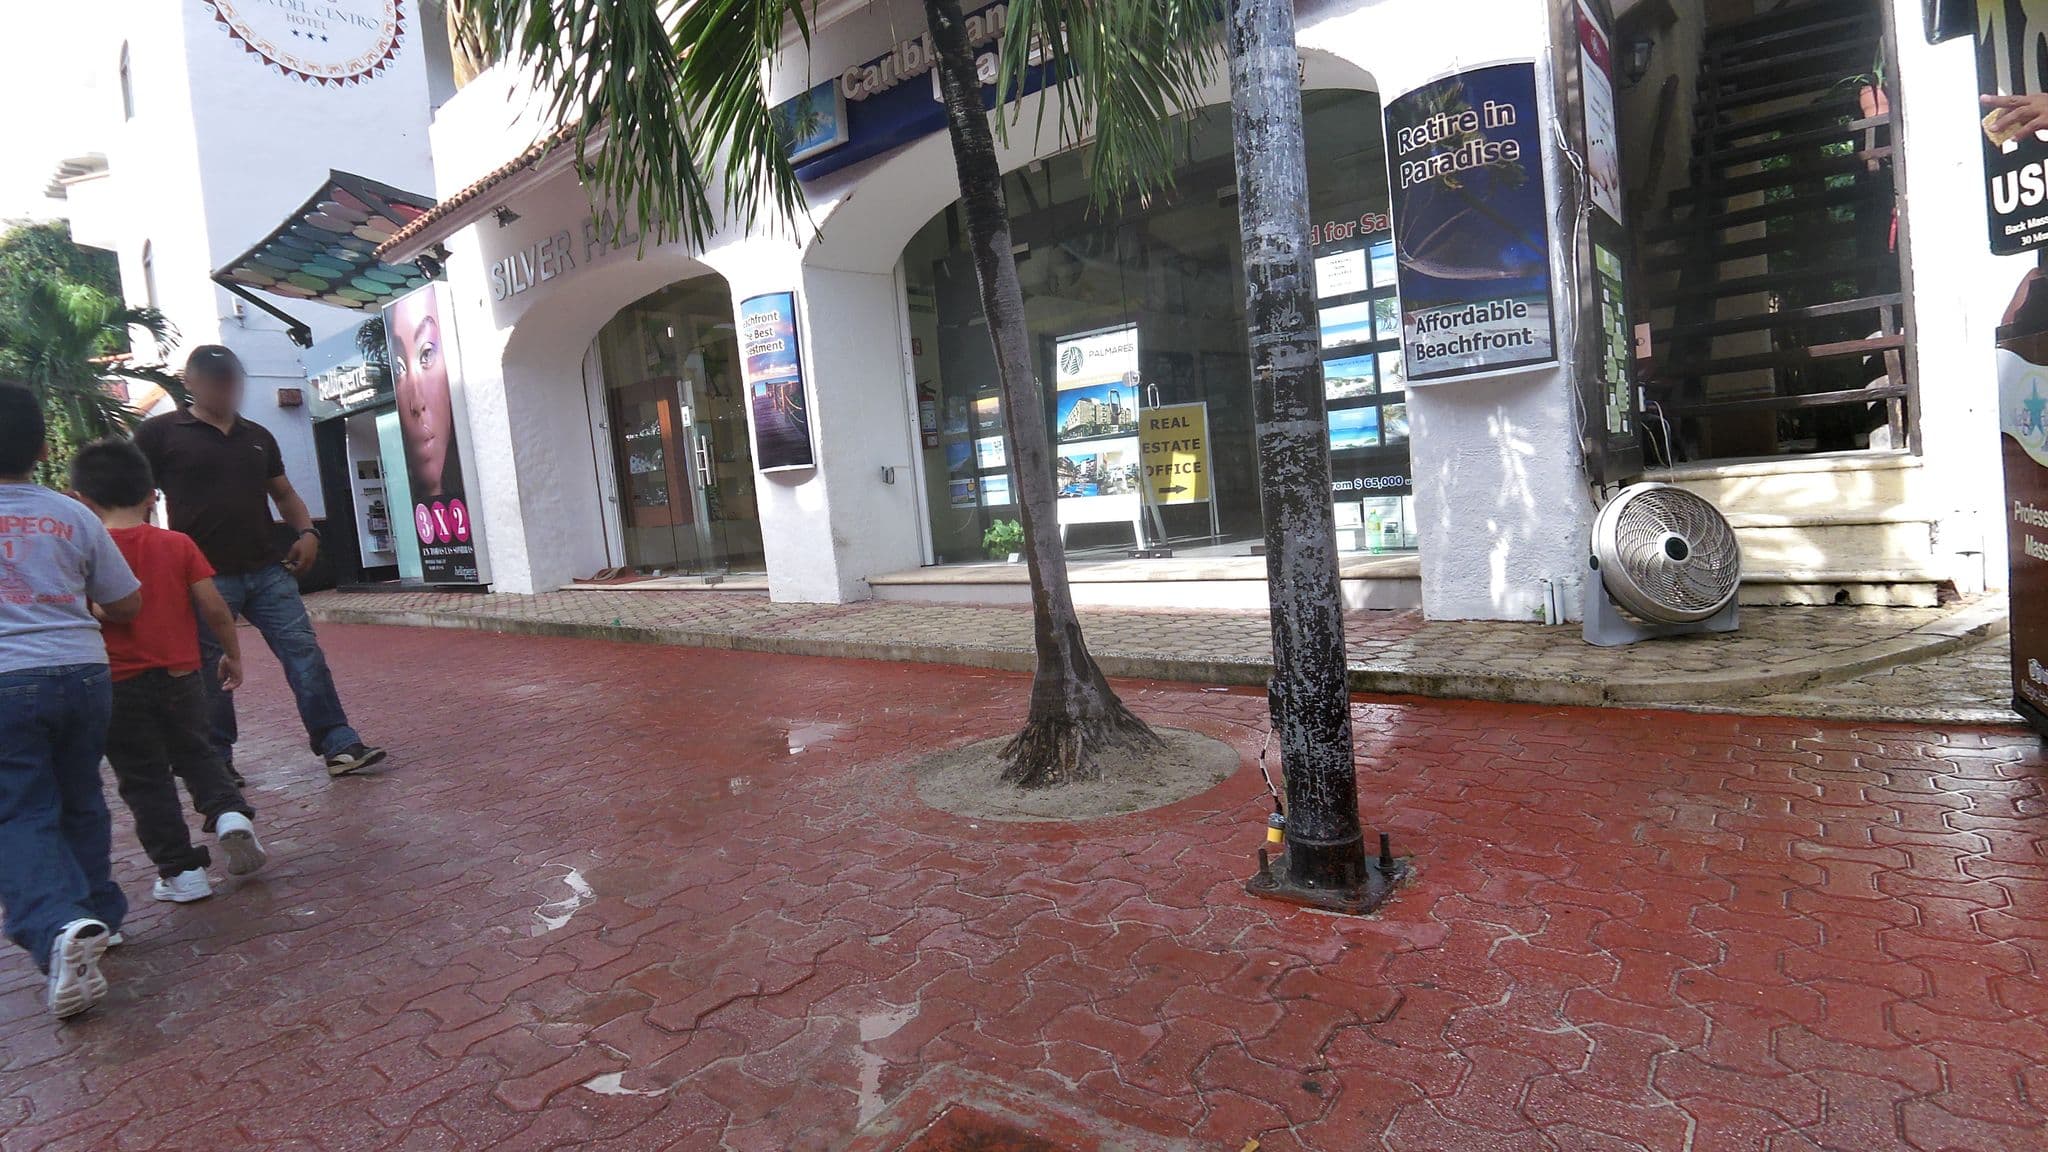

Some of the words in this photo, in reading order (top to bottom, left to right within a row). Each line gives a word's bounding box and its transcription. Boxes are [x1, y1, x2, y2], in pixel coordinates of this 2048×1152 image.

[286, 13, 328, 30] HOTEL
[314, 6, 380, 31] CENTRO
[1398, 111, 1478, 155] Retire
[1483, 100, 1516, 128] in
[1400, 139, 1520, 189] Paradise
[1991, 158, 2048, 214] US
[1324, 221, 1356, 242] for
[491, 229, 576, 301] SILVER
[1415, 299, 1528, 335] Affordable
[754, 327, 774, 340] Best
[1415, 327, 1534, 361] Beachfront
[1088, 343, 1134, 358] PALMARES
[1150, 416, 1190, 430] REAL
[1142, 438, 1201, 454] ESTATE
[1331, 481, 1353, 491] rom
[1363, 475, 1404, 489] 65,000
[4, 540, 14, 559] 1
